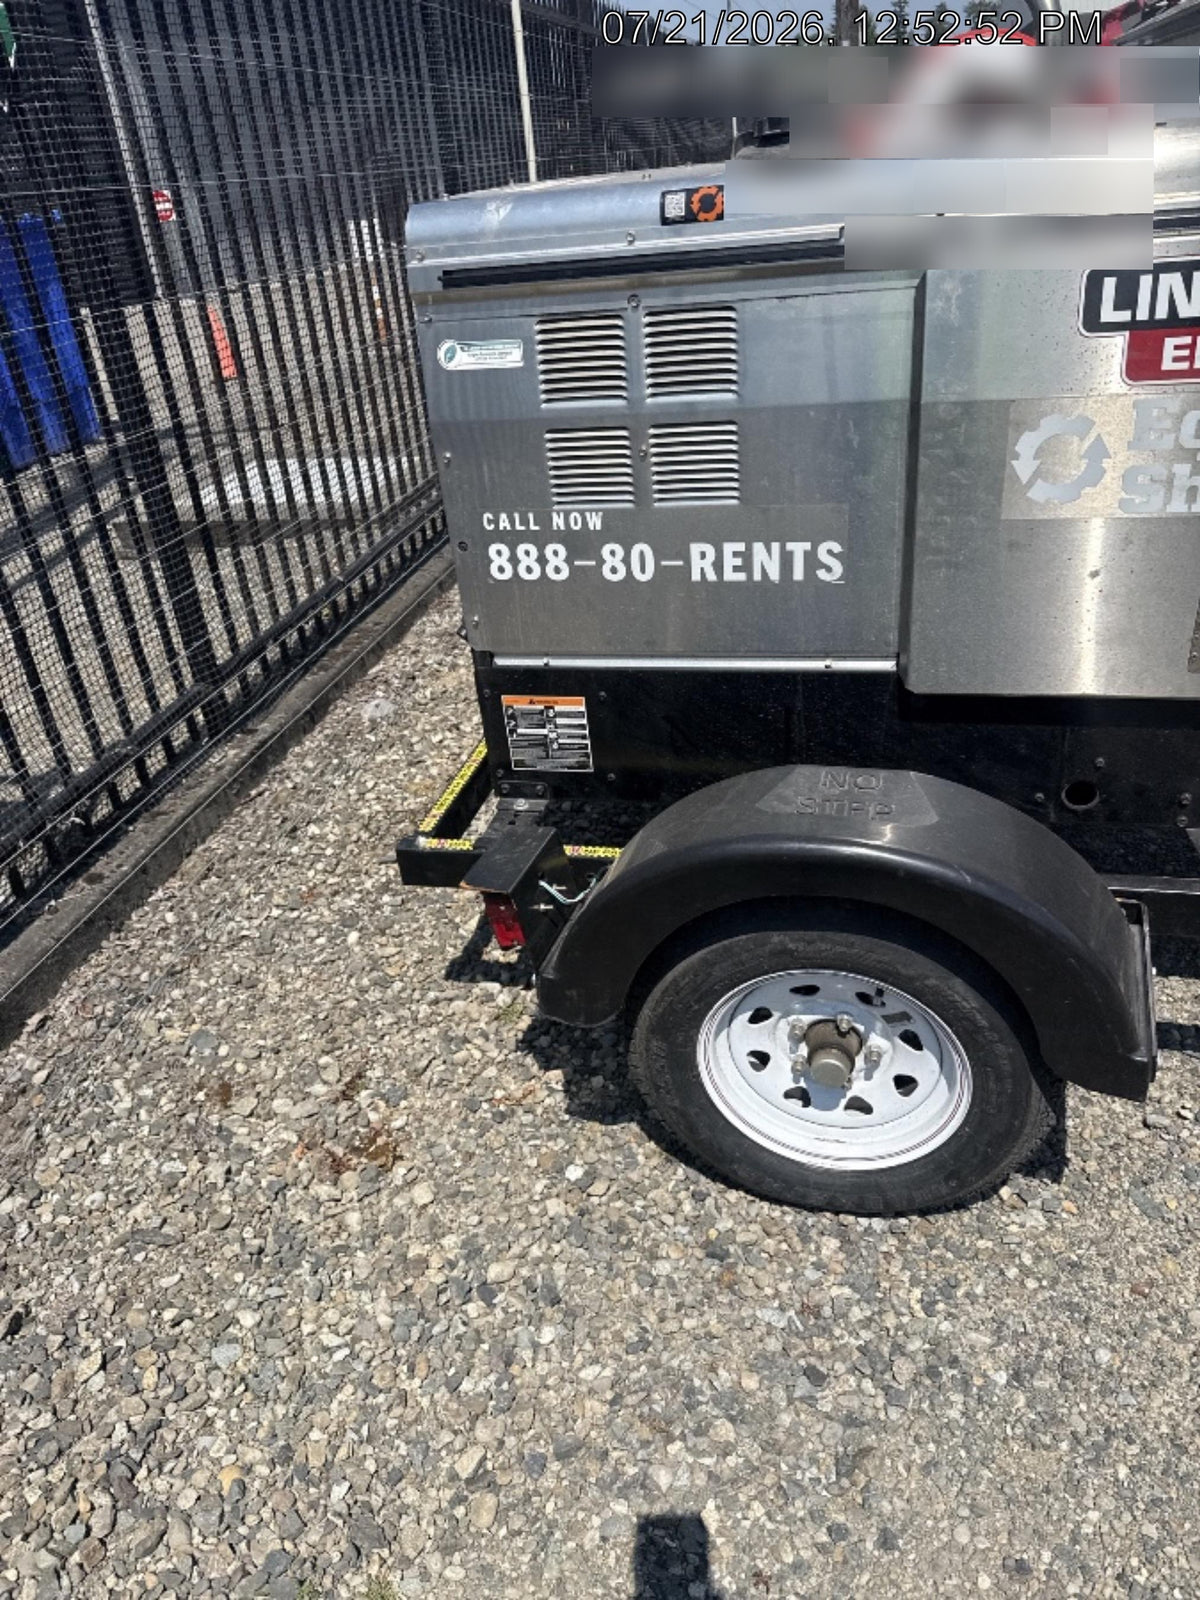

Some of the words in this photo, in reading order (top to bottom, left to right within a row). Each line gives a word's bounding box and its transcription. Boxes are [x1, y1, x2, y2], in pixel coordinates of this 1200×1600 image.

[1100, 271, 1200, 322] LIN
[1160, 335, 1200, 370] E
[482, 511, 541, 531] CALL
[552, 511, 604, 531] NOW
[487, 541, 844, 583] 888-80-RENTS
[820, 770, 883, 792] NO
